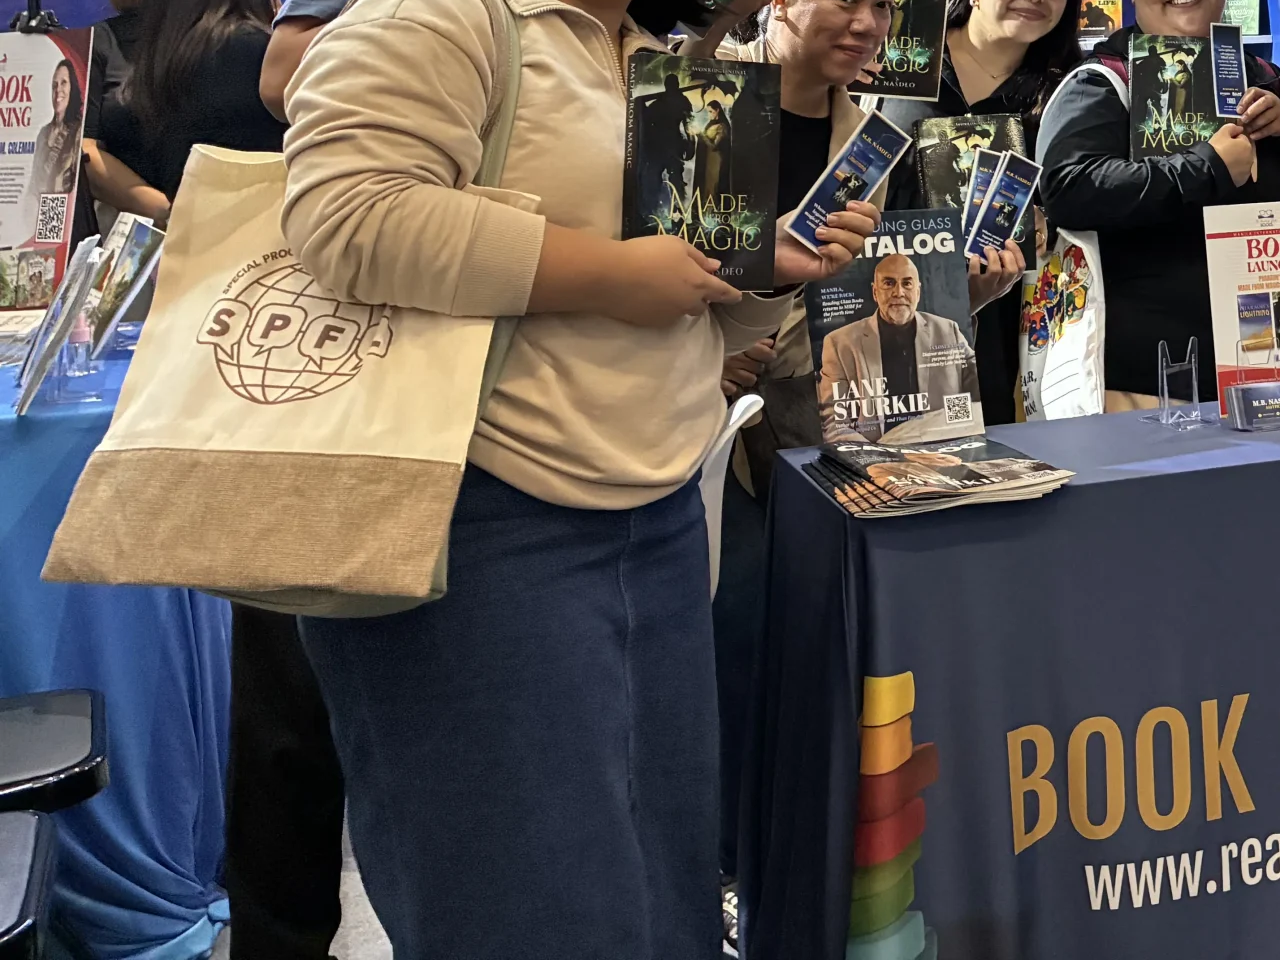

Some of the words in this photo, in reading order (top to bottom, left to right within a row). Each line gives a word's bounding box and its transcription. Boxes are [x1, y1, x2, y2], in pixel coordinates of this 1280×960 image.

[1149, 106, 1205, 132] MADE
[663, 180, 748, 228] MADE
[911, 217, 952, 231] GLASS
[856, 231, 955, 259] TALOG
[222, 260, 262, 294] SPECIAL
[831, 377, 889, 401] LANE
[833, 392, 931, 421] STURKIE
[836, 441, 987, 454] CATALOG
[1006, 691, 1257, 857] BOOK
